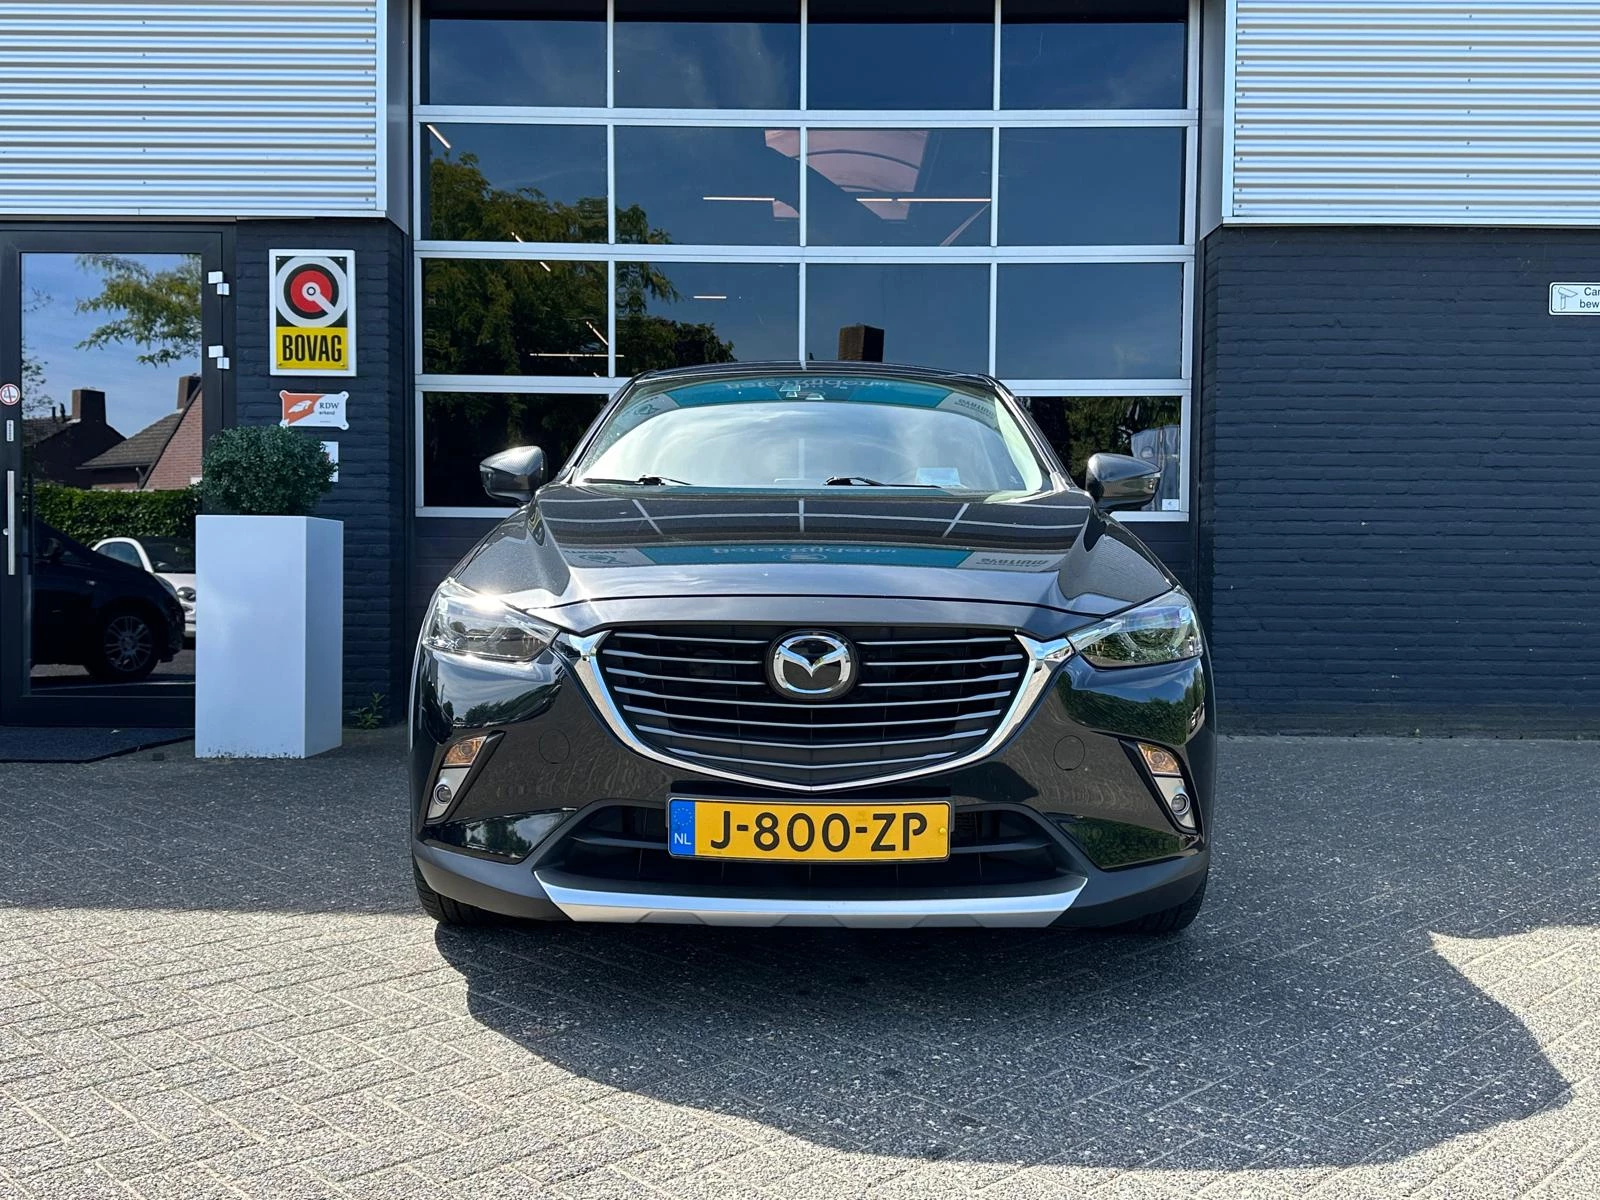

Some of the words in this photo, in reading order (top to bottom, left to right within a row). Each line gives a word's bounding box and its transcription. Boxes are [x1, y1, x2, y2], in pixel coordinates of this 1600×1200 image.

[282, 334, 342, 362] BOVAG
[674, 832, 691, 845] NL
[710, 810, 928, 852] J-800-ZP
